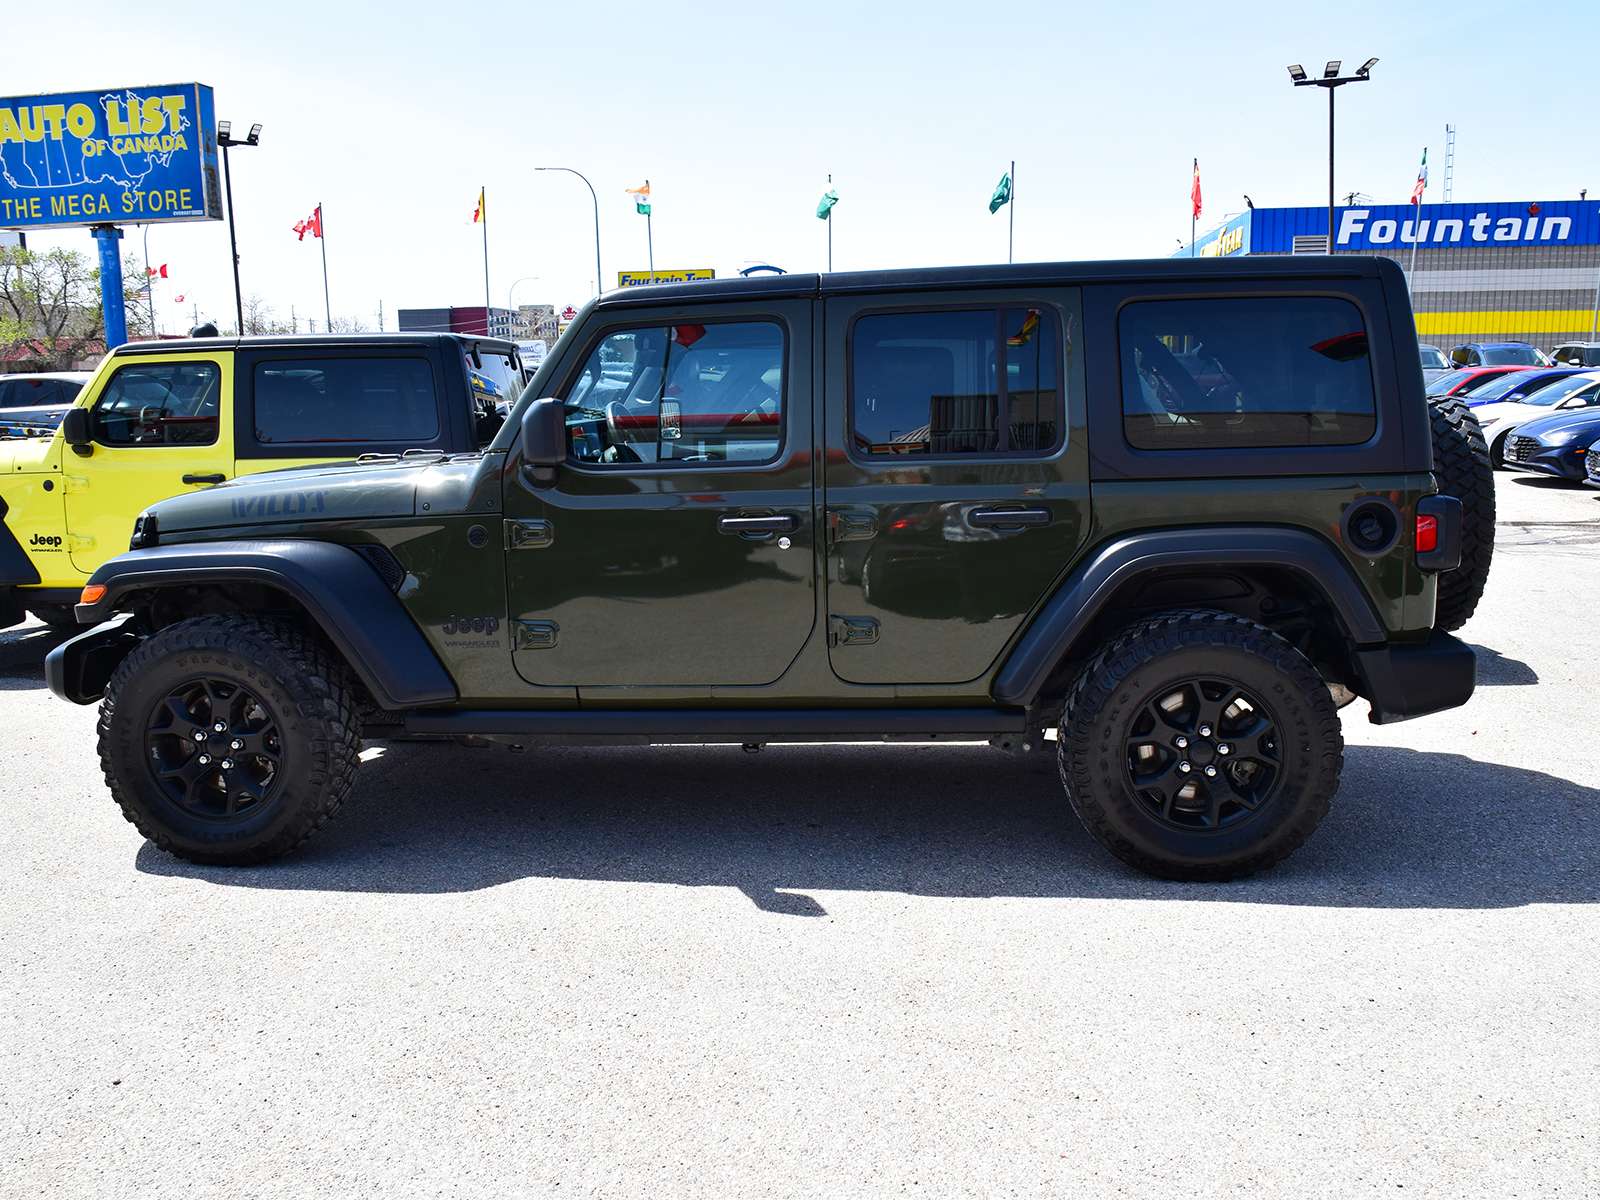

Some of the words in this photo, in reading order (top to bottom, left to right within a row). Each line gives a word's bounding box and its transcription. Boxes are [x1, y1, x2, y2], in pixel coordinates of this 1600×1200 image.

[0, 103, 96, 144] AUTO
[106, 95, 186, 137] LIST
[81, 140, 107, 157] OF
[113, 134, 188, 155] CANADA
[3, 197, 43, 220] THE
[51, 193, 111, 217] MEGA
[122, 188, 193, 213] STORE
[1336, 204, 1572, 244] Fountain
[30, 533, 63, 547] Jeep
[441, 613, 499, 636] Jeep
